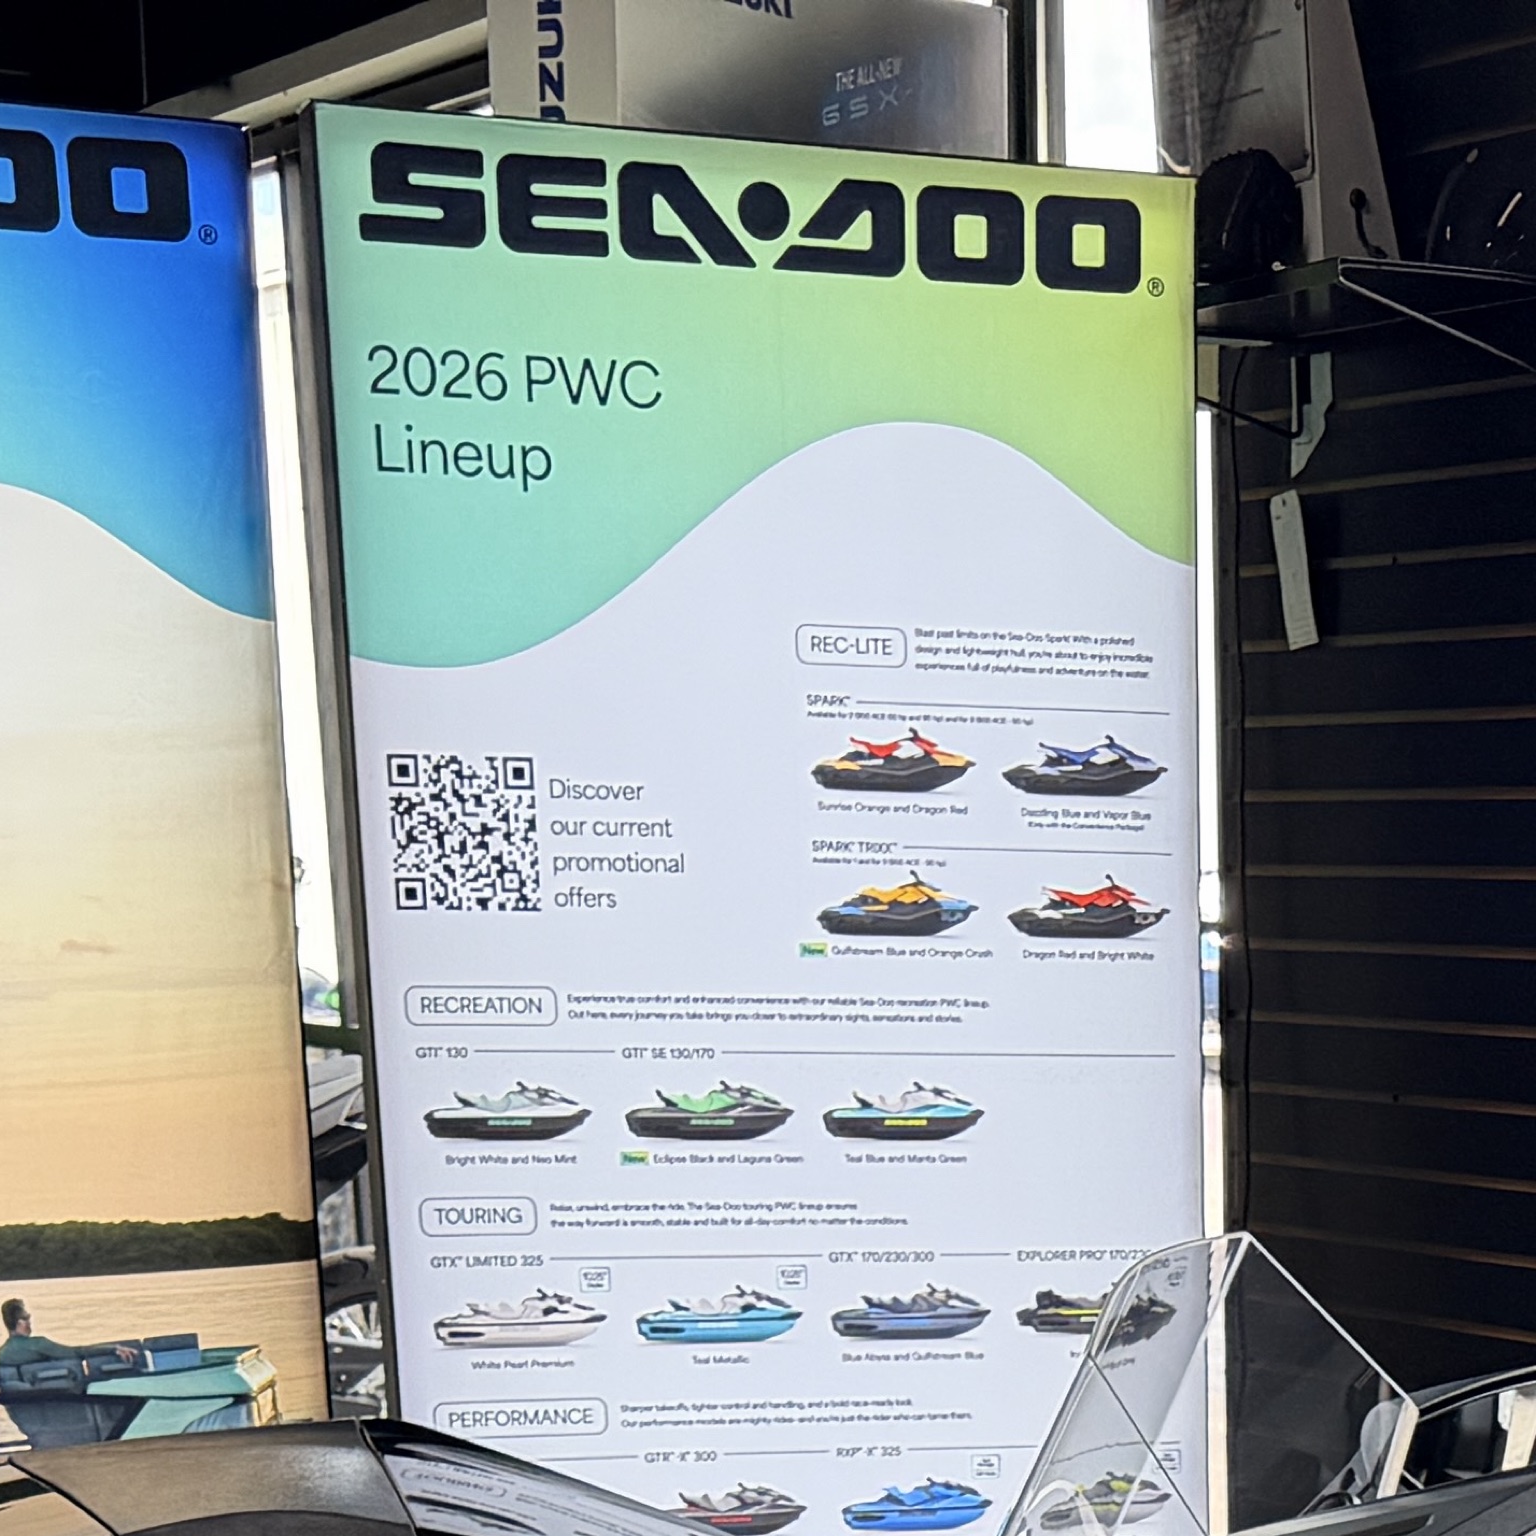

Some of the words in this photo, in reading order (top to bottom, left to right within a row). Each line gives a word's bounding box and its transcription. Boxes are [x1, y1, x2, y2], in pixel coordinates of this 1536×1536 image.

[367, 345, 508, 401] 2026
[526, 355, 662, 409] PWC
[374, 423, 552, 492] Lineup
[810, 634, 894, 656] REC-LITE
[548, 777, 645, 801] Discover
[854, 802, 891, 815] Orange
[893, 804, 911, 813] and
[1083, 810, 1100, 819] and
[550, 819, 587, 836] our
[592, 818, 674, 838] current
[552, 851, 685, 877] promotional
[553, 886, 618, 908] offers
[909, 948, 925, 957] and
[927, 948, 963, 960] Orange
[1079, 950, 1095, 960] and
[420, 996, 543, 1014] RECREATION
[445, 1154, 476, 1167] Bright
[479, 1155, 509, 1165] White
[512, 1155, 529, 1164] and
[717, 1154, 735, 1164] and
[888, 1154, 906, 1163] and
[433, 1206, 524, 1225] TOURING
[465, 1255, 518, 1268] LIMITED
[447, 1406, 595, 1429] PERFORMANCE
